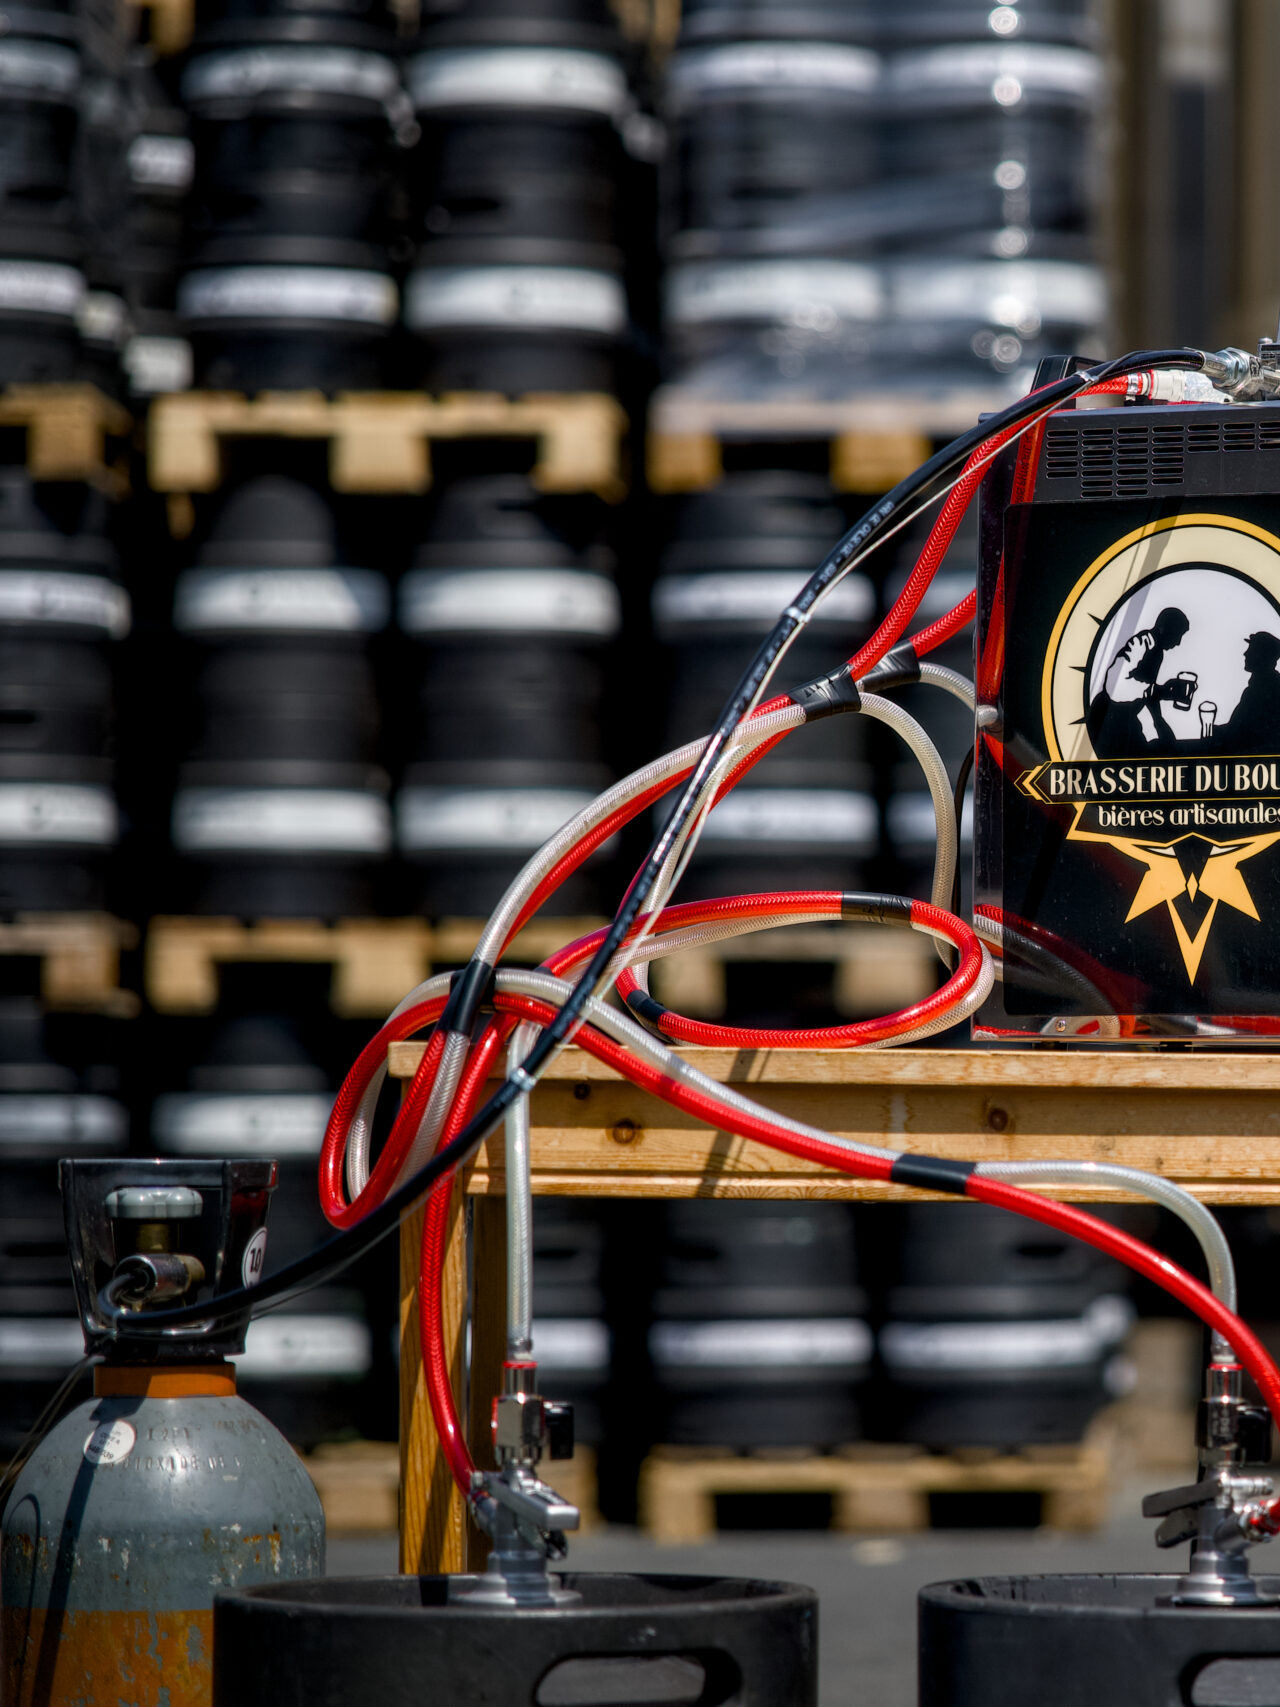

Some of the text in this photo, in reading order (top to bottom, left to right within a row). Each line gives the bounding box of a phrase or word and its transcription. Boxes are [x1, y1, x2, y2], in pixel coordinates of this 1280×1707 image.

[1050, 765, 1189, 796] BRASSERIE
[1195, 763, 1228, 793] DU
[1098, 804, 1165, 828] bières
